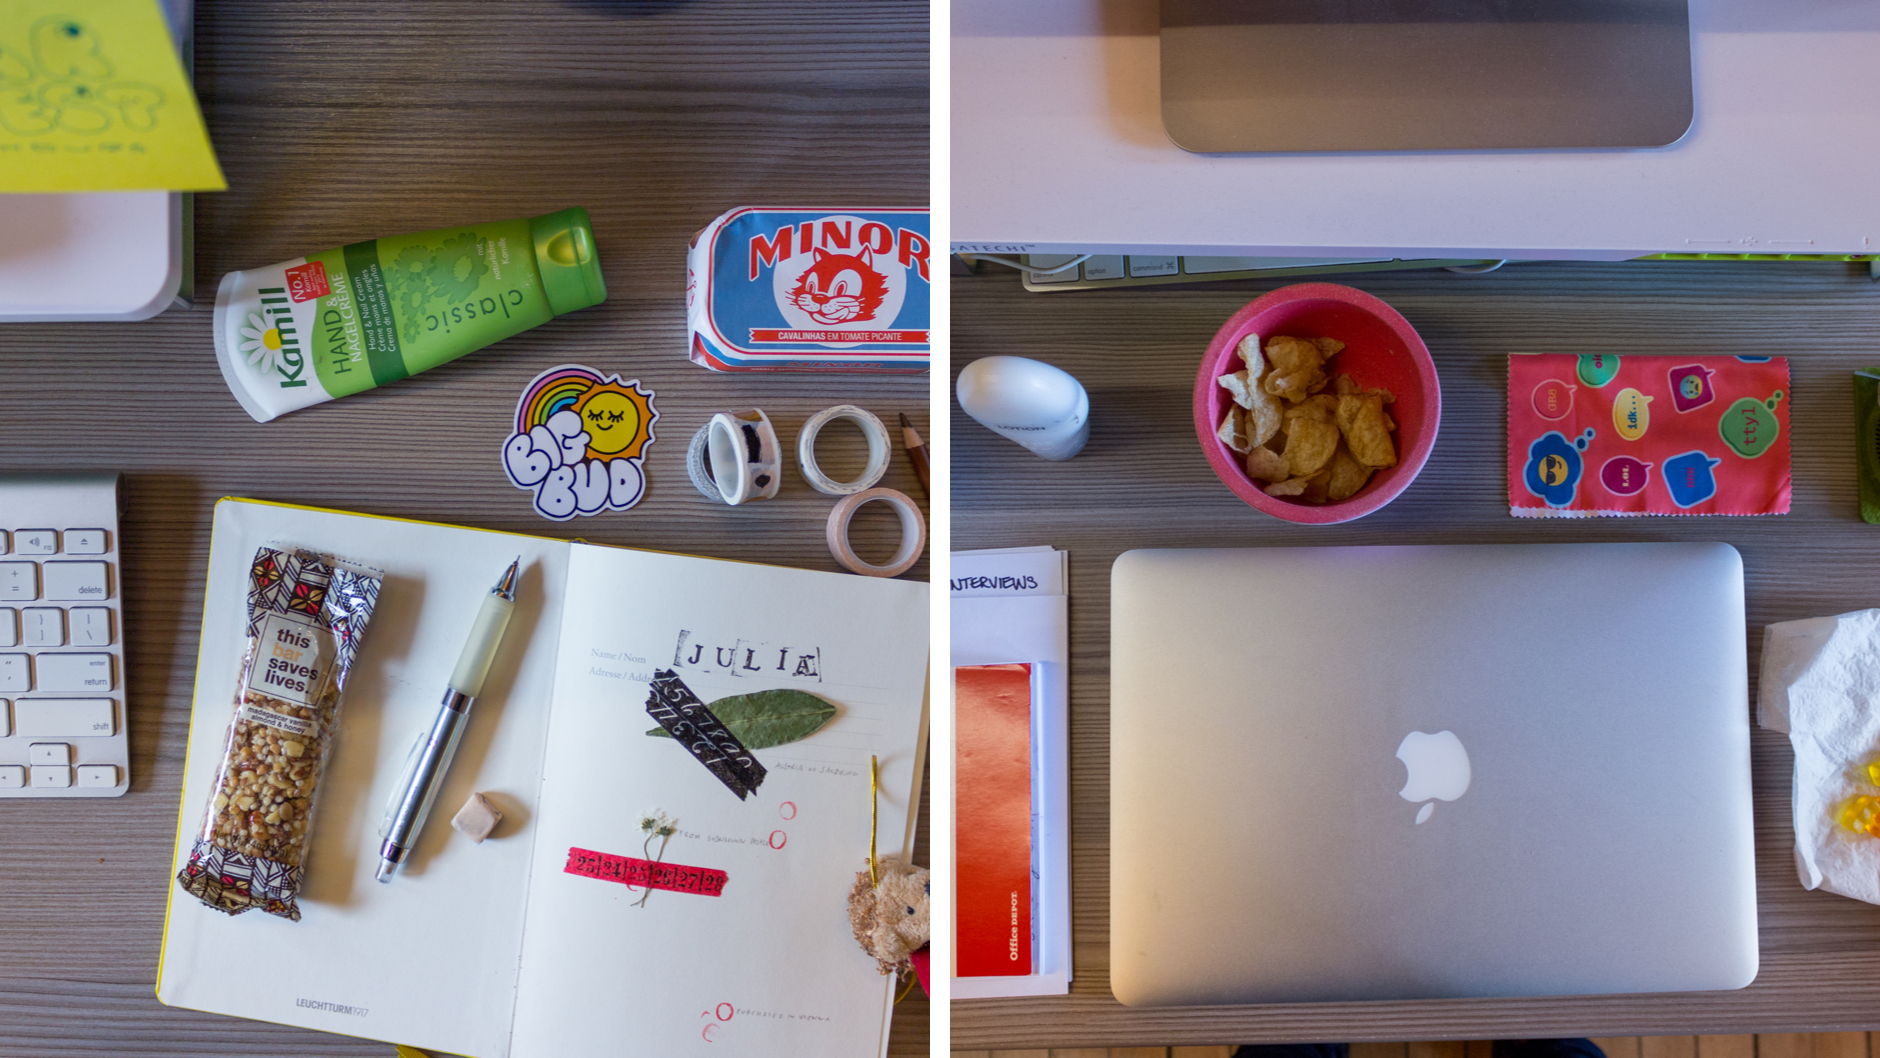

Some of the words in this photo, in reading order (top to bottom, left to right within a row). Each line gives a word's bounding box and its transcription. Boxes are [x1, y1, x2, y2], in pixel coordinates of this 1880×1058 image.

[488, 240, 502, 280] natürlicher
[749, 220, 930, 282] MINOR
[362, 269, 374, 293] ongles
[370, 264, 380, 282] uñas
[354, 276, 366, 301] Cream
[370, 293, 375, 302] et
[326, 297, 338, 306] &
[360, 303, 370, 319] Nail
[378, 291, 388, 318] manos
[426, 290, 523, 334] classic
[382, 316, 390, 326] de
[258, 287, 307, 388] Kamill
[323, 309, 352, 374] HAND
[368, 330, 376, 350] Hand
[376, 328, 386, 352] Crème
[385, 328, 396, 352] Crema
[778, 332, 826, 340] CAVALINHAS
[827, 332, 839, 340] EM
[840, 332, 870, 340] TOMATE
[872, 332, 902, 341] PICANTE
[1548, 388, 1557, 412] GR8
[1741, 407, 1759, 446] ttyl
[504, 410, 592, 486] BIG
[536, 456, 643, 519] BUD
[277, 628, 310, 648] this
[272, 642, 304, 662] bar
[591, 648, 616, 660] Name
[624, 653, 646, 664] Nom
[688, 644, 818, 677] JULIA
[268, 658, 318, 680] saves
[589, 667, 622, 678] Adresse
[264, 669, 310, 694] lives.
[247, 706, 288, 723] madagascar
[290, 718, 312, 728] vanilla
[251, 715, 276, 726] almond
[284, 722, 306, 734] honey
[1010, 927, 1018, 960] Office
[296, 998, 369, 1018] LEUCHTTURM1917
